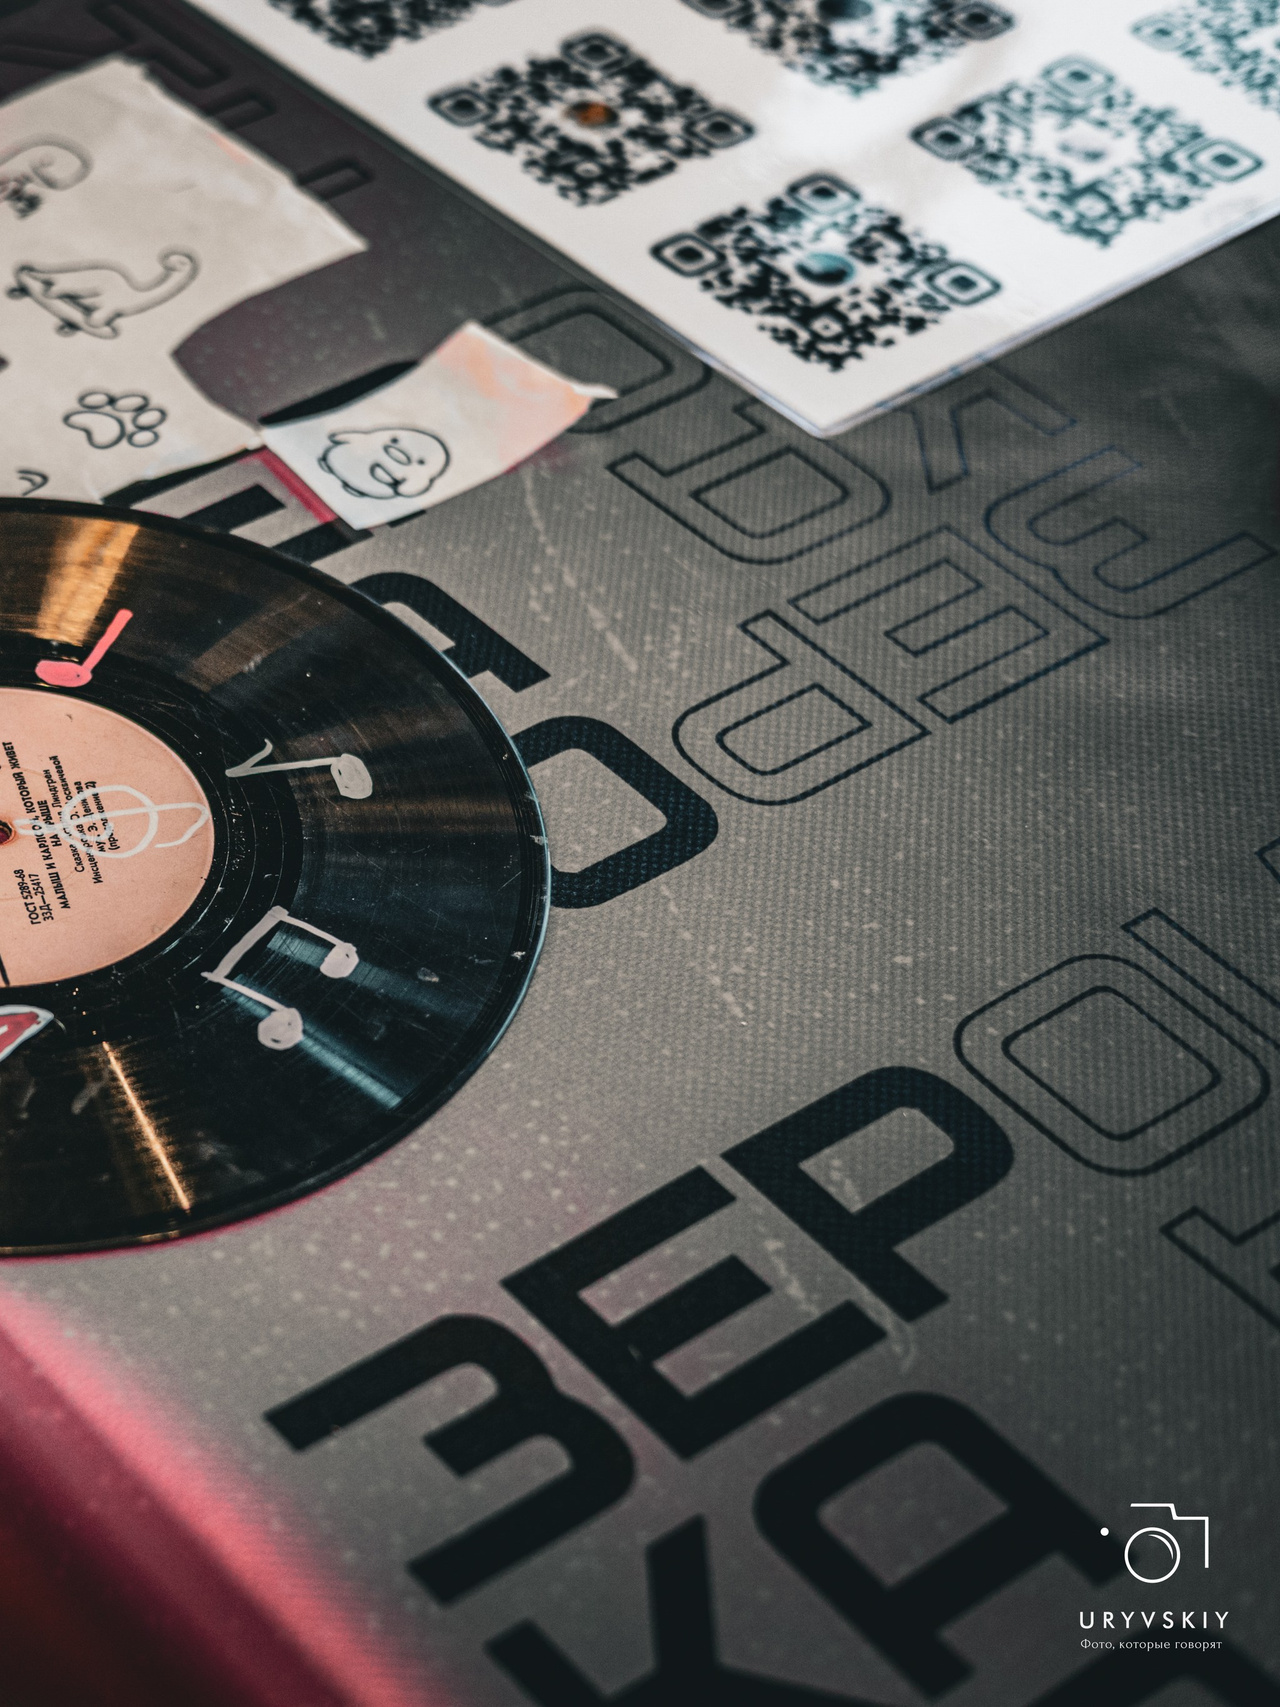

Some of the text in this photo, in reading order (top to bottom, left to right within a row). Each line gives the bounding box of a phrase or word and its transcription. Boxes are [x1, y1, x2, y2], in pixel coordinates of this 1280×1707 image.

[1, 741, 20, 770] ЖИВЕТ
[12, 771, 36, 814] КОТОРЫЙ
[43, 769, 62, 808] Линдгрен
[49, 756, 76, 810] осквичевой
[37, 800, 62, 848] НА РЫШЕ
[93, 833, 108, 853] му.
[45, 862, 56, 870] И
[13, 869, 40, 925] ГОСТ 5289-68
[49, 871, 70, 910] МАЛЫШ
[263, 1065, 1015, 1608] ЗЕР
